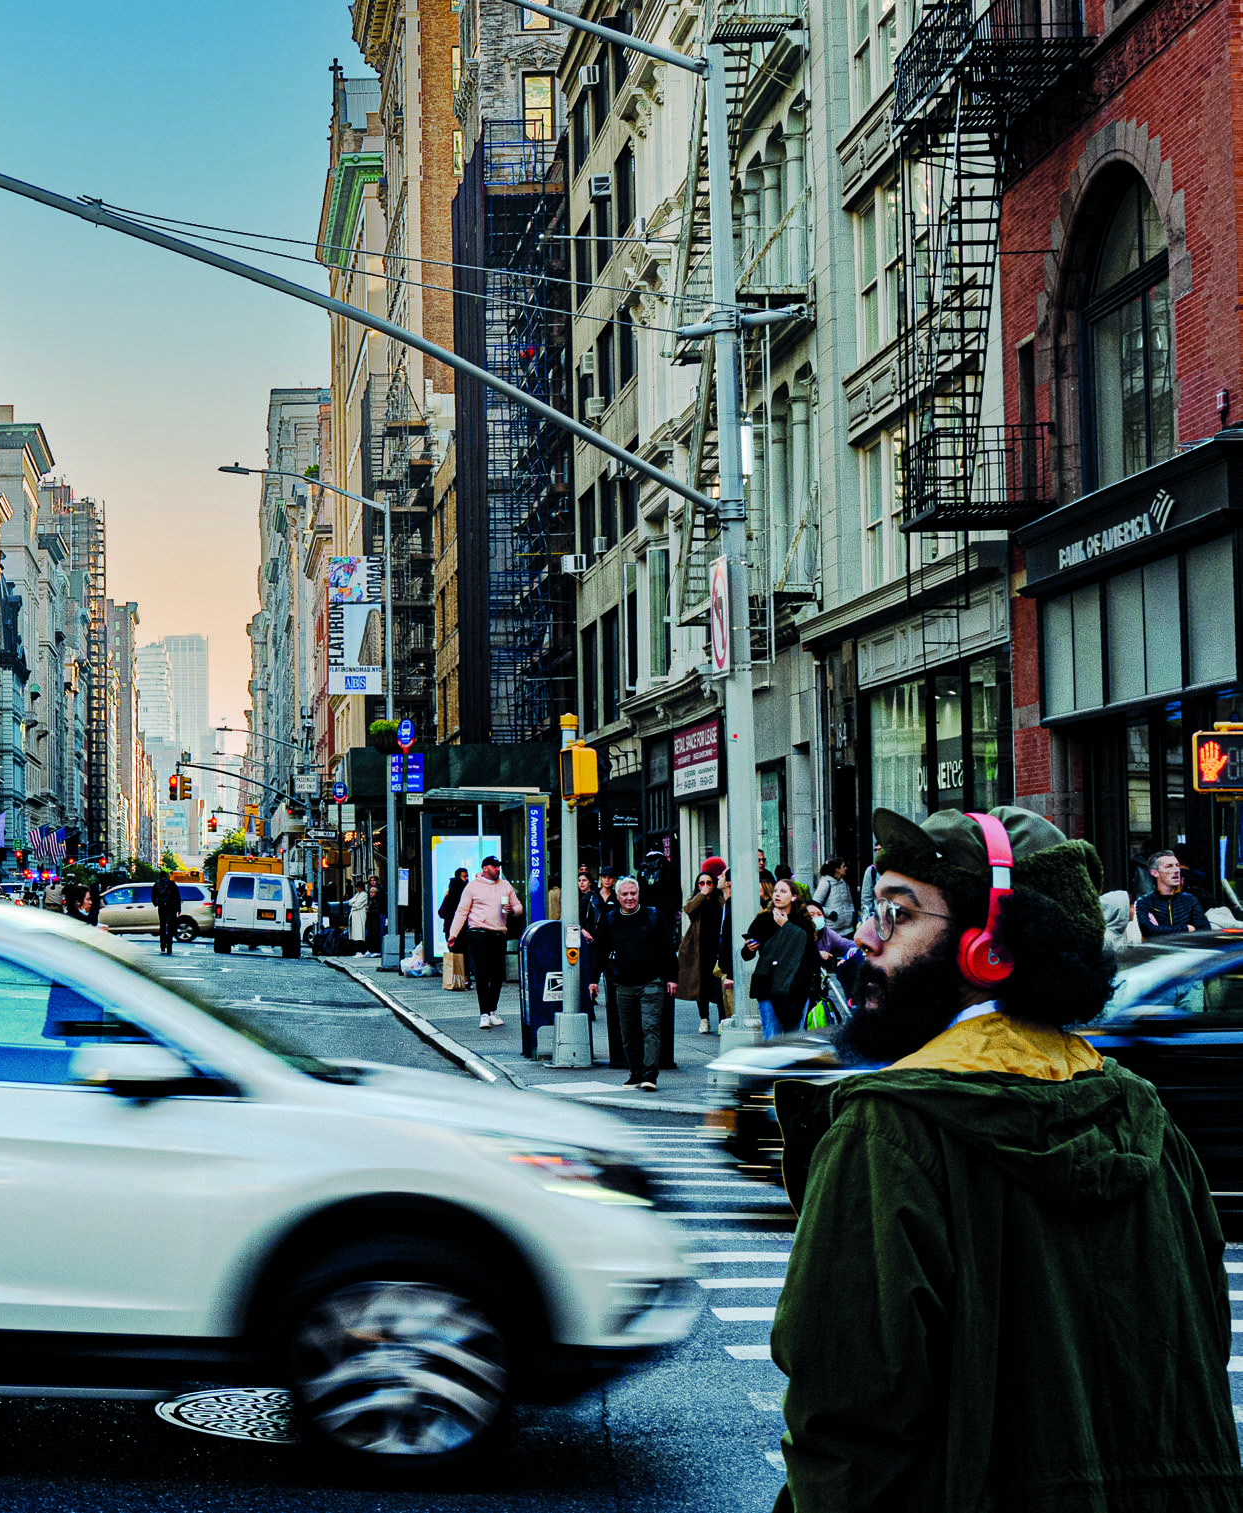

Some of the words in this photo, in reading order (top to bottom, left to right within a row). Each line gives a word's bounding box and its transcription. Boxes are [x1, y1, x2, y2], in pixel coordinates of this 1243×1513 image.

[1059, 540, 1086, 570] BANK
[1087, 533, 1101, 558] OF
[1101, 512, 1152, 553] AMERICA
[329, 602, 344, 666] FLATIRON
[345, 676, 366, 689] ABS
[705, 726, 717, 746] LEASE
[530, 816, 539, 847] Avenue
[531, 857, 540, 867] 23
[531, 869, 540, 878] St
